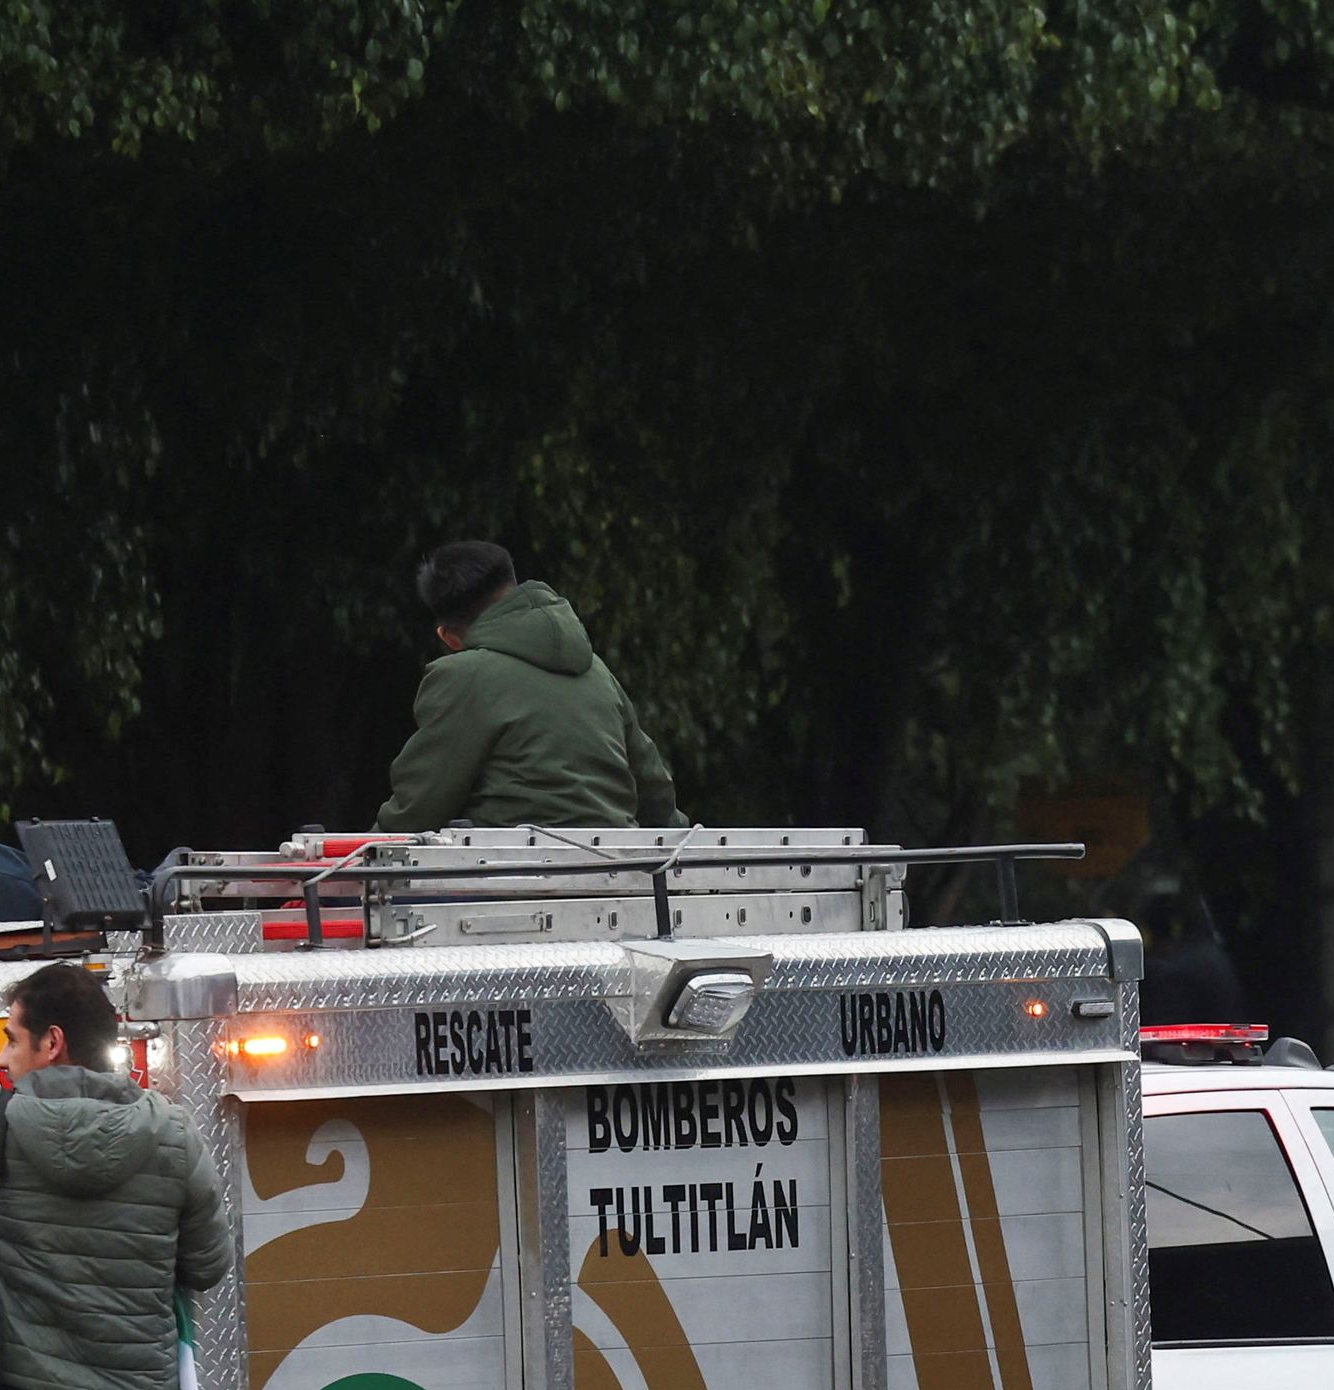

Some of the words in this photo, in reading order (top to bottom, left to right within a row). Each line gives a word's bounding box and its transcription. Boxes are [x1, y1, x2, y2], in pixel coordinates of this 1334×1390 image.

[414, 1010, 533, 1075] RESCATE
[840, 989, 946, 1056] URBANO
[586, 1075, 798, 1153] BOMBEROS
[589, 1162, 799, 1258] TULTITLÁN
